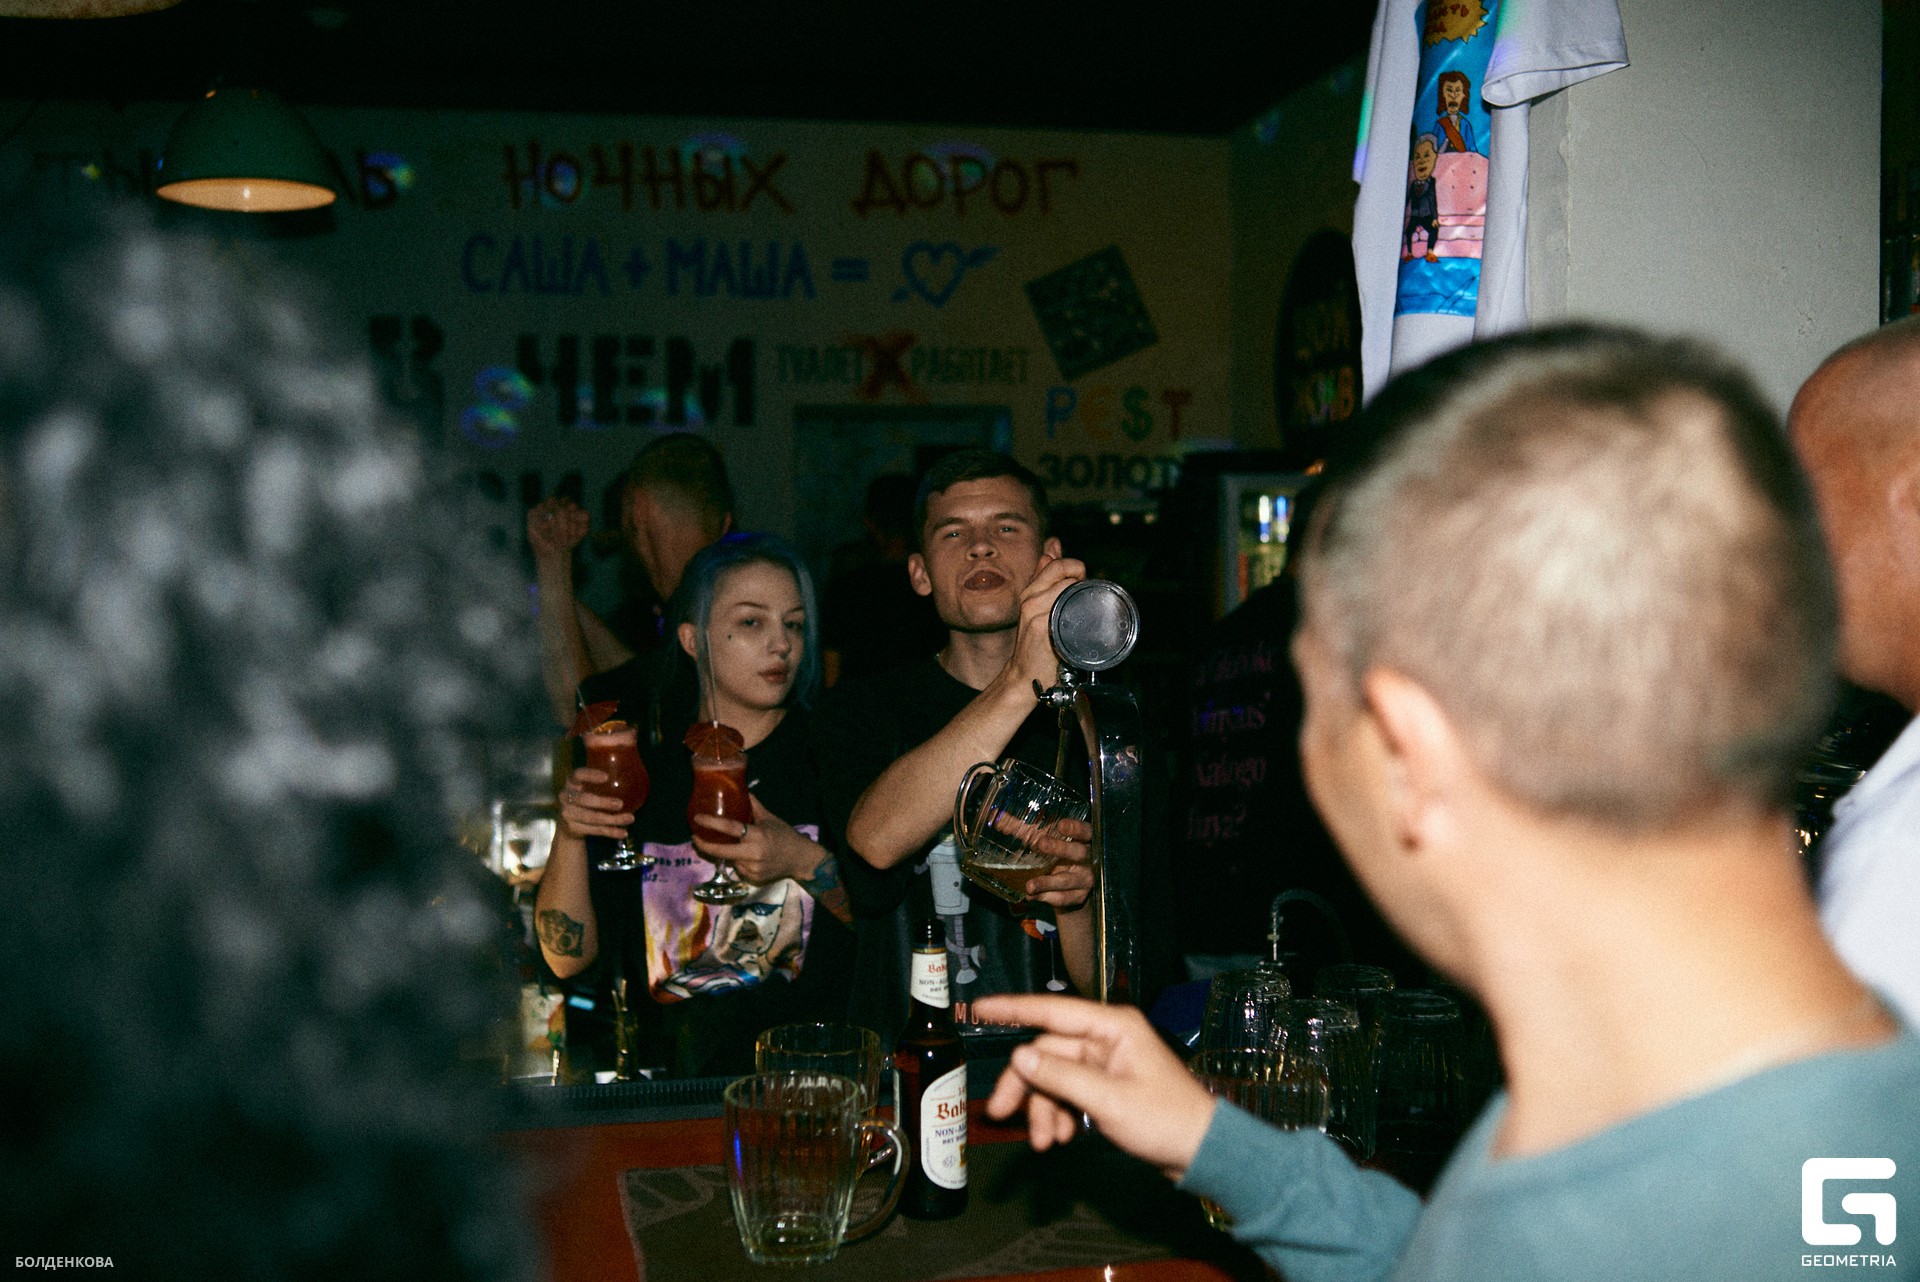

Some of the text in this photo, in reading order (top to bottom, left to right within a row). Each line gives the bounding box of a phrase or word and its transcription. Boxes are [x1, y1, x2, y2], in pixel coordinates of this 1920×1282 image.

[503, 139, 796, 214] НОЧНЫХ
[848, 147, 1081, 217] ДОРОГ
[461, 231, 611, 297] САША
[666, 236, 816, 301] МАША
[515, 332, 756, 427] ЧЕМ
